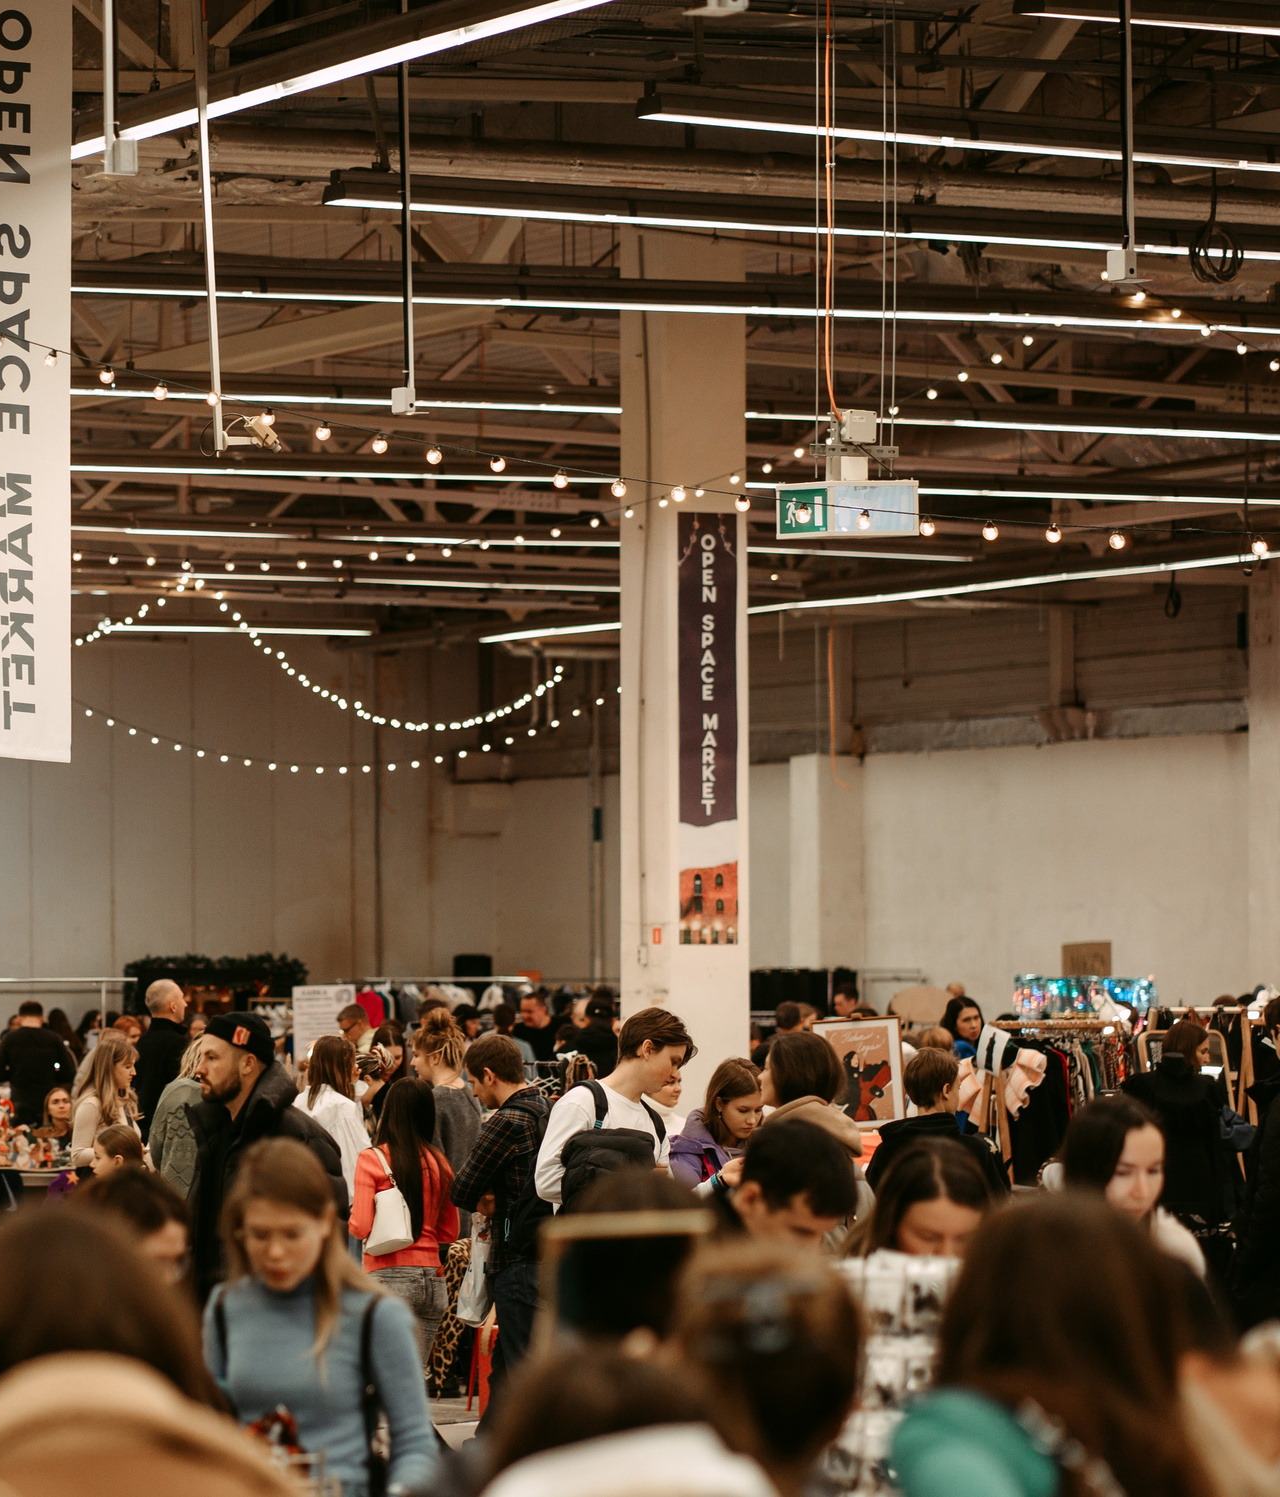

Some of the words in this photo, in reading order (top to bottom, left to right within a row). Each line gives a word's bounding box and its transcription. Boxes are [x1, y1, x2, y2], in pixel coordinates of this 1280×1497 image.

[700, 533, 717, 603] OPEN
[700, 614, 716, 701] SPACE
[701, 713, 718, 816] MARKET
